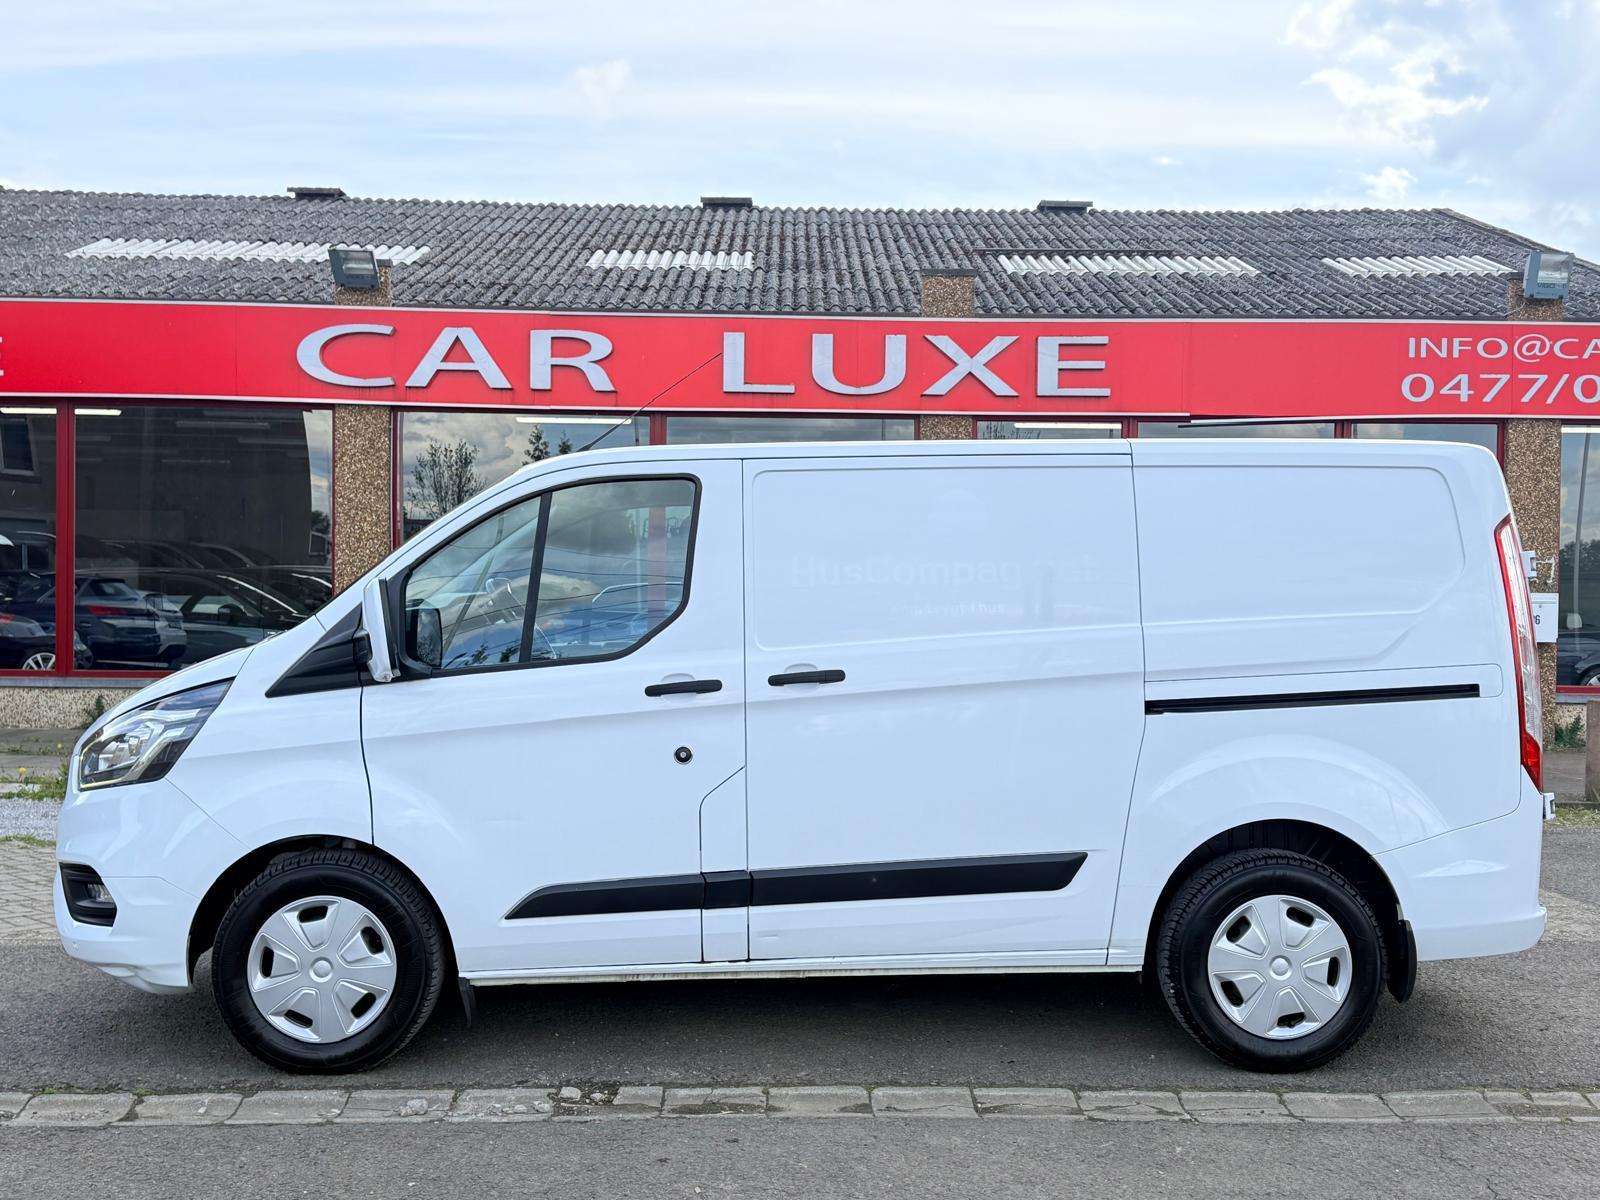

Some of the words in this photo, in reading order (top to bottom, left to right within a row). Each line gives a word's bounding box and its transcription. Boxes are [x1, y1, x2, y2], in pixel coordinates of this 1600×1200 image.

[296, 323, 616, 392] CAR
[722, 331, 1112, 397] LUXE
[1401, 373, 1600, 404] 0477/0
